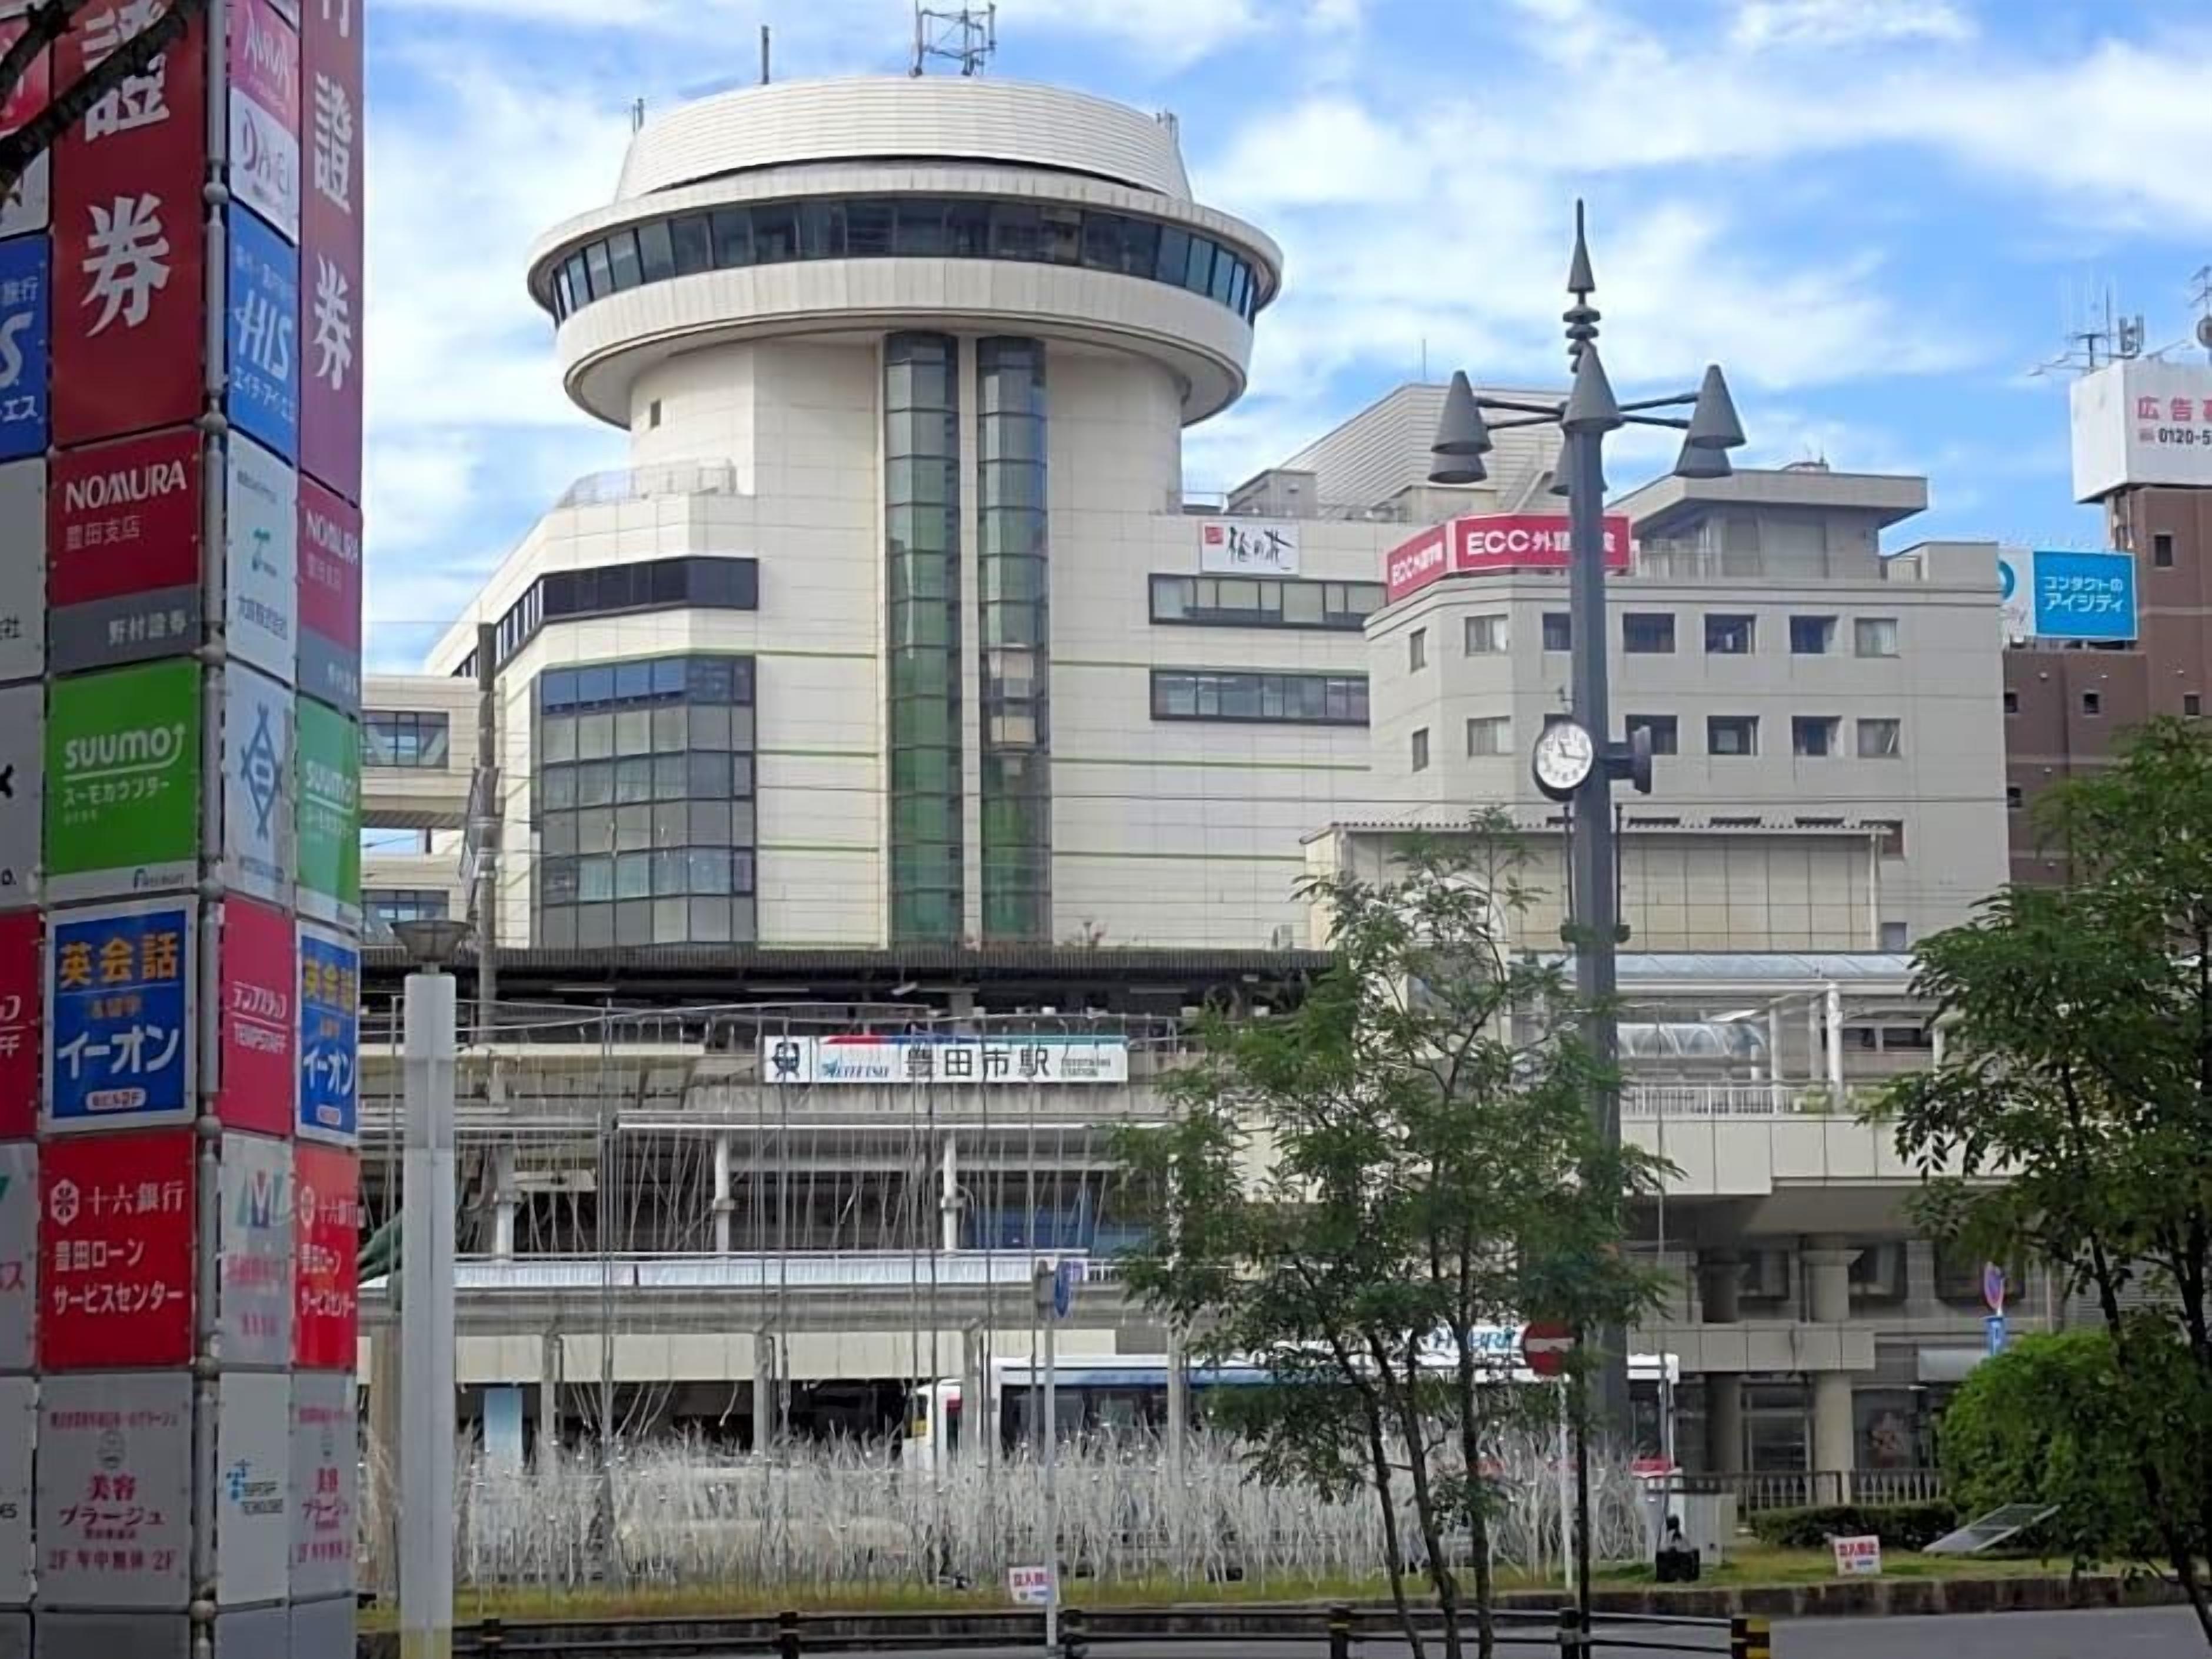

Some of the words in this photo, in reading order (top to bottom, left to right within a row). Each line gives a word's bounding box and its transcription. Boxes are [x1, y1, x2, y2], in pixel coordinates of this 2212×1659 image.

[64, 459, 187, 513] NOMURA
[2043, 575, 2124, 591] コンタクトの
[2044, 592, 2124, 612] アイシティ
[63, 776, 171, 809] スーモカウンター
[59, 931, 179, 990] 英会話
[57, 1024, 179, 1081] イーオン
[302, 1045, 354, 1096] イーオン
[905, 1044, 1051, 1079] 豊田市駅
[85, 1179, 186, 1217] 十六銀行
[55, 1237, 145, 1273] 豊田ローン
[53, 1280, 184, 1316] サービスセンター
